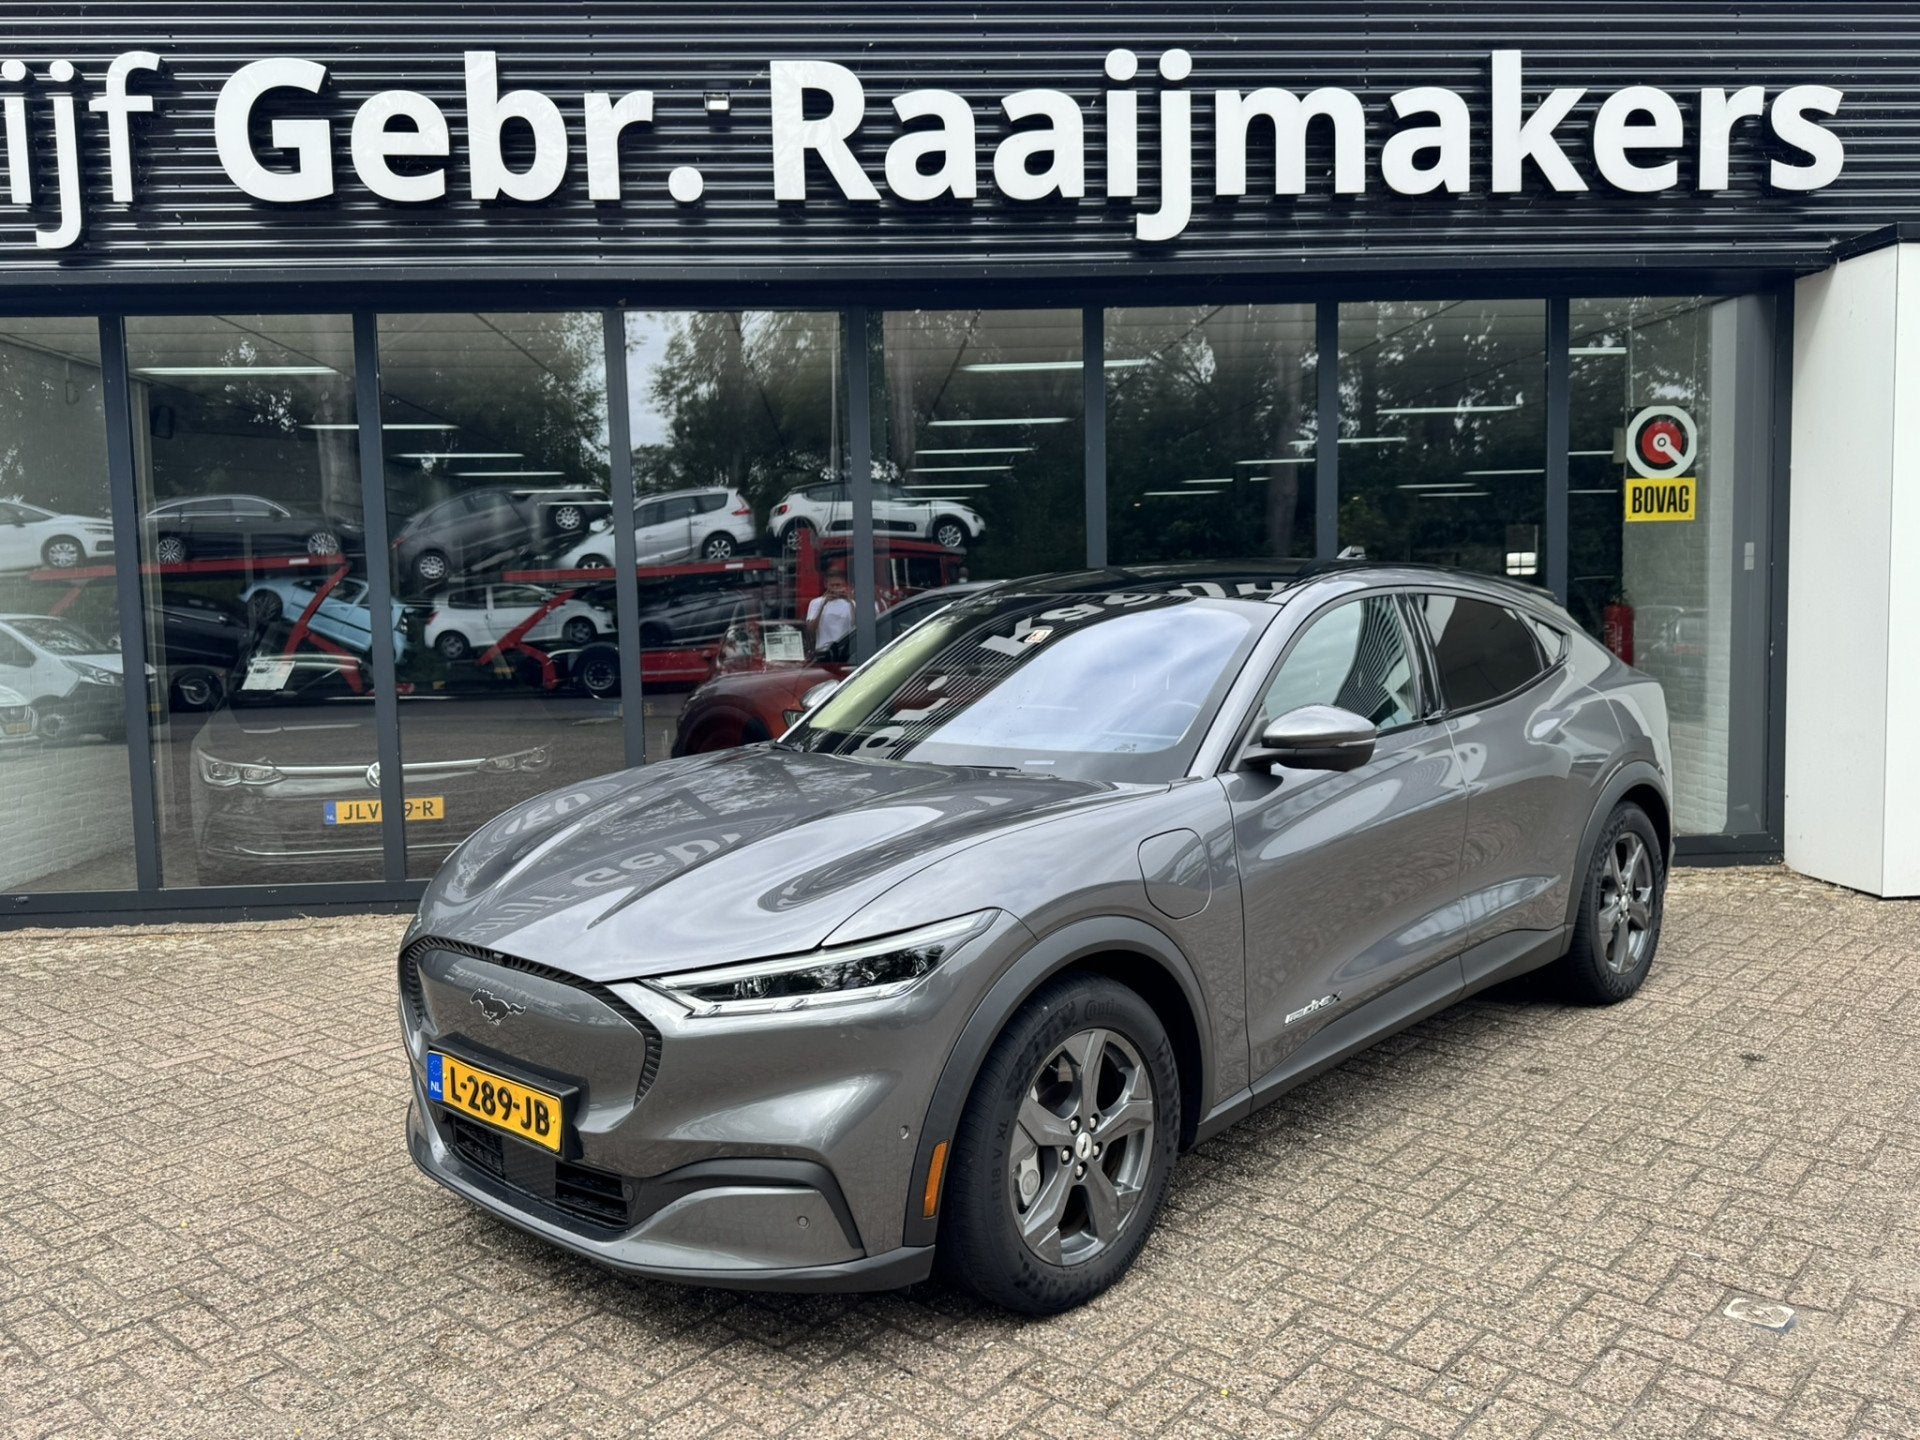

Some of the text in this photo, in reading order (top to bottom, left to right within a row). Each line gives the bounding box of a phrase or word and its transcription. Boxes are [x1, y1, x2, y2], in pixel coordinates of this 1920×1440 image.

[1, 48, 1845, 250] ijf Gebr. Raaijmakers
[1632, 485, 1690, 513] BOVAG
[343, 800, 434, 820] JLV9-R
[430, 1080, 442, 1094] NL
[449, 1065, 551, 1137] L-289-JB
